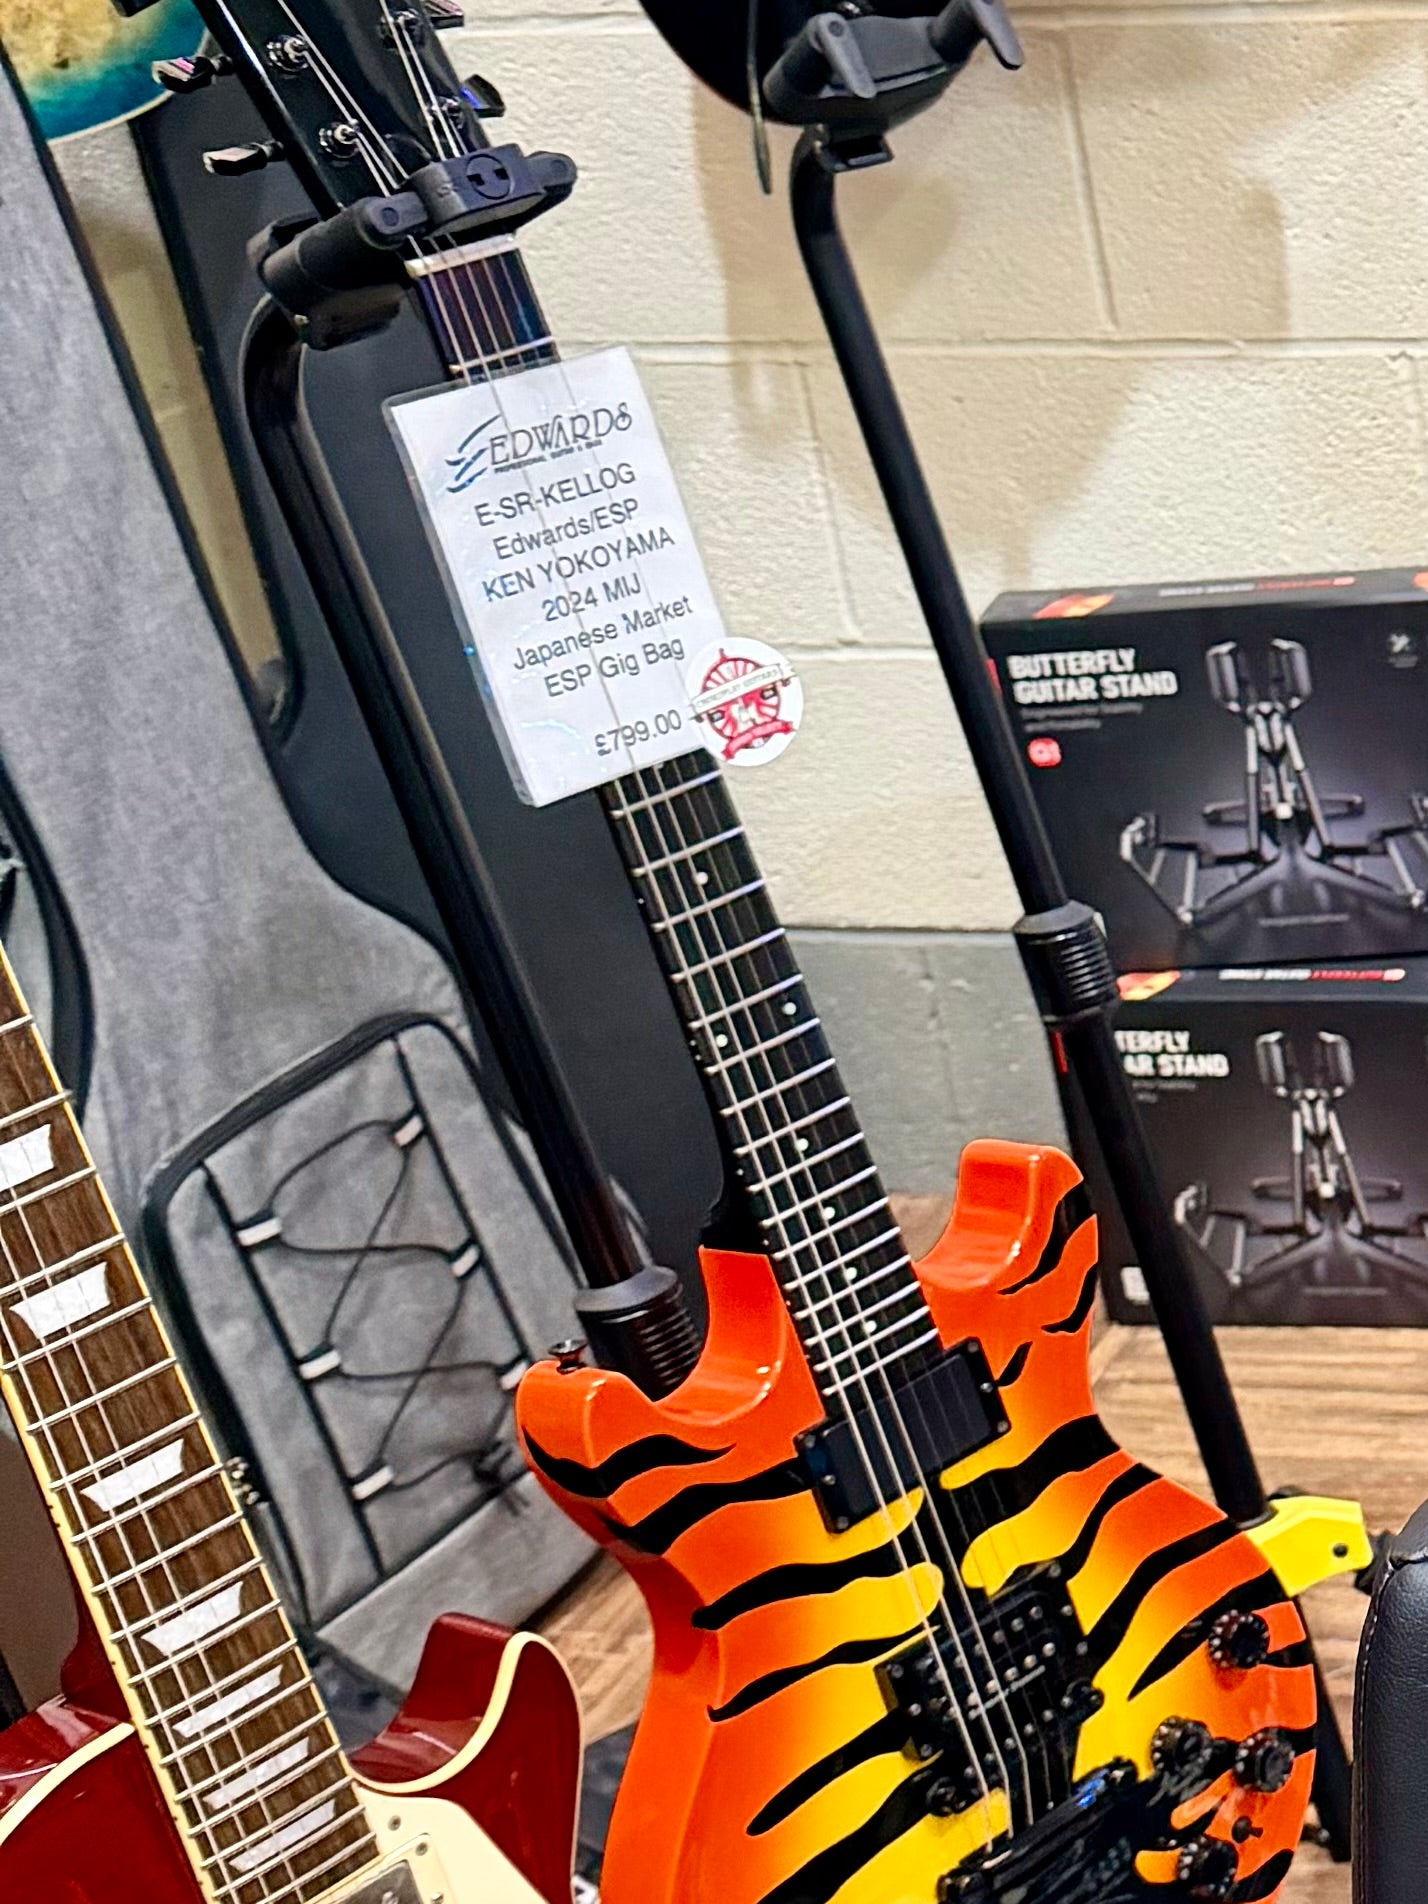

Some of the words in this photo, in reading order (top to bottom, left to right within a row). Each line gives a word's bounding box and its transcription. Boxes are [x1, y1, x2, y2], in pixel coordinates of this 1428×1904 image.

[490, 402, 633, 466] EDWARDS
[475, 463, 636, 526] E-SR-KELLOG
[493, 499, 640, 560] Edwards/ESP
[482, 565, 535, 602] KEN
[542, 526, 675, 584] YOKOYAMA
[542, 586, 599, 622] 2024
[604, 574, 642, 605] MIJ
[513, 624, 618, 672] Japanese
[624, 596, 693, 635] Market
[545, 665, 592, 698] ESP
[599, 652, 640, 687] Gig
[645, 637, 685, 672] Bag
[1006, 648, 1136, 679] BUTTERFLY
[1013, 676, 1099, 704] GUITAR
[1100, 671, 1178, 699] STAND
[595, 710, 682, 756] £799.00
[1114, 1030, 1190, 1053] TERFLY
[1157, 1053, 1230, 1077] STAND
